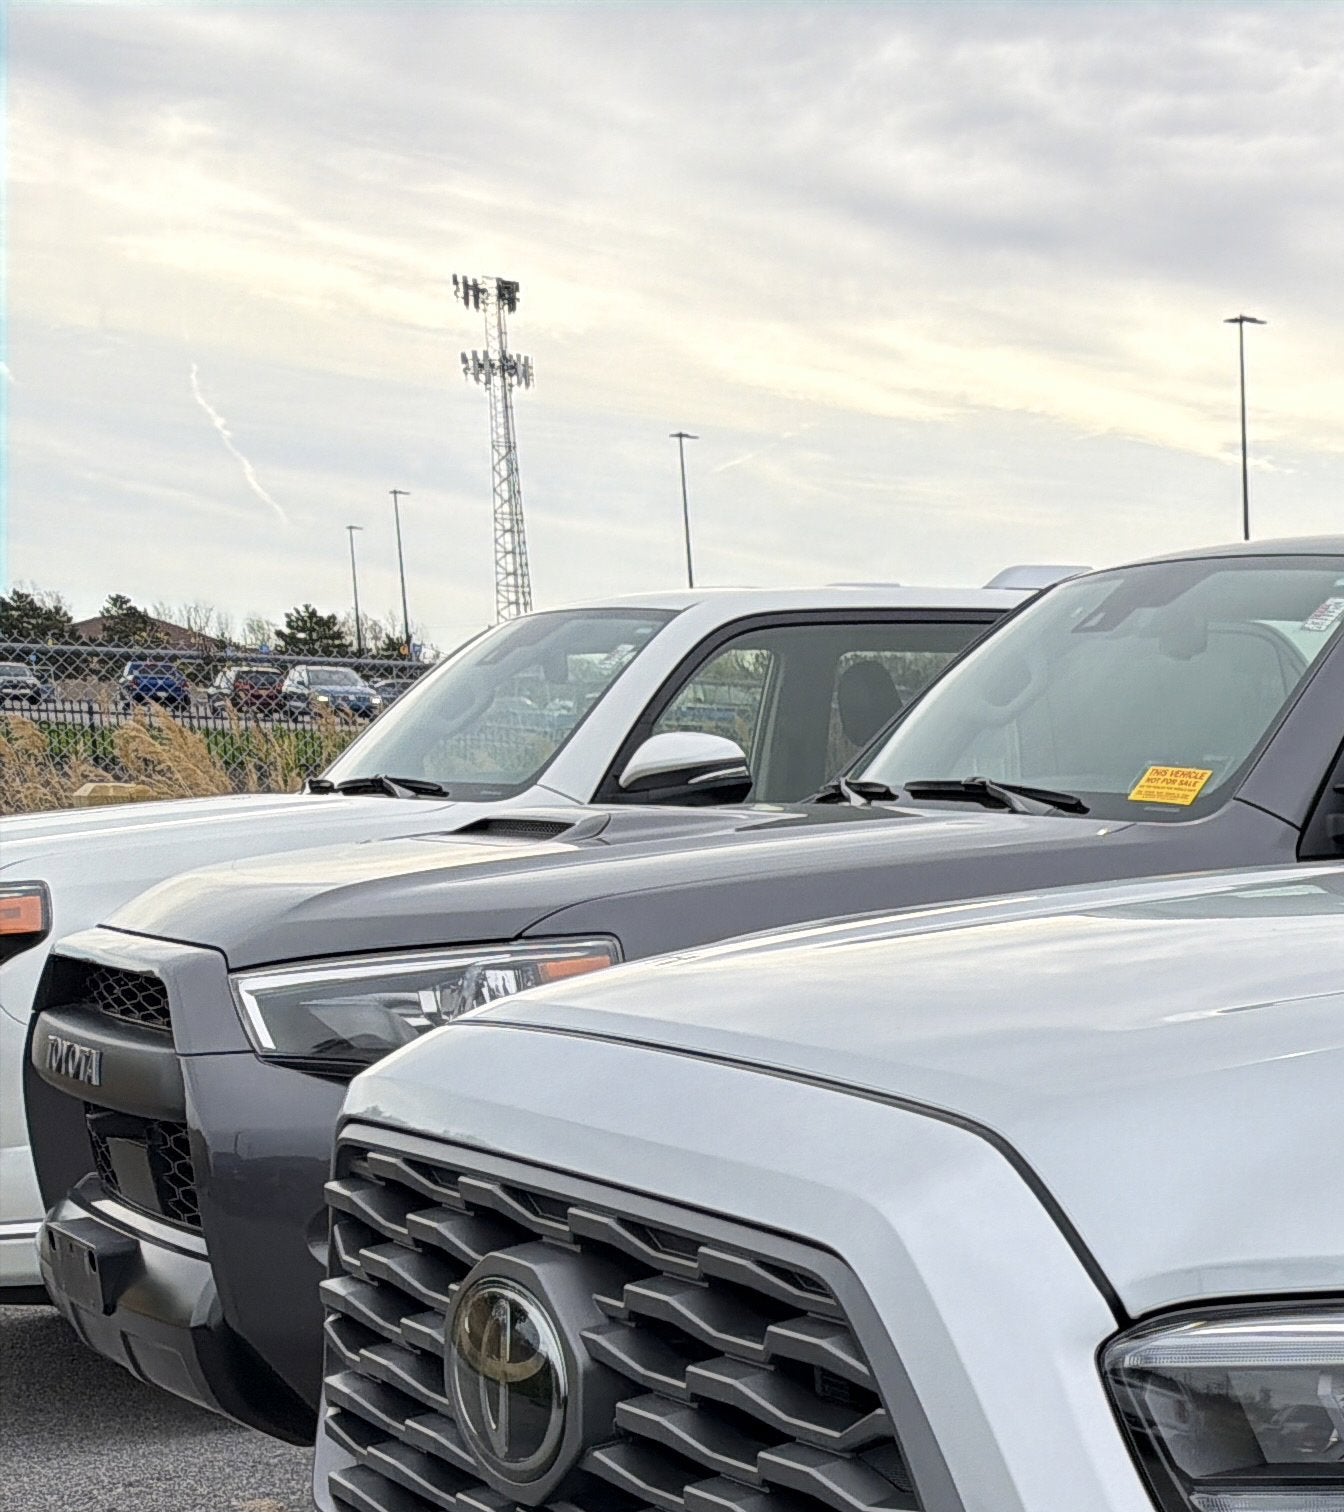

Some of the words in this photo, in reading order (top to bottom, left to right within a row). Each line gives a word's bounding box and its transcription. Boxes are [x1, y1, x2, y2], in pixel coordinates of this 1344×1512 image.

[1150, 769, 1168, 777] THIS
[1170, 770, 1208, 780] VEHICLE
[46, 1034, 103, 1087] TOYOTA
